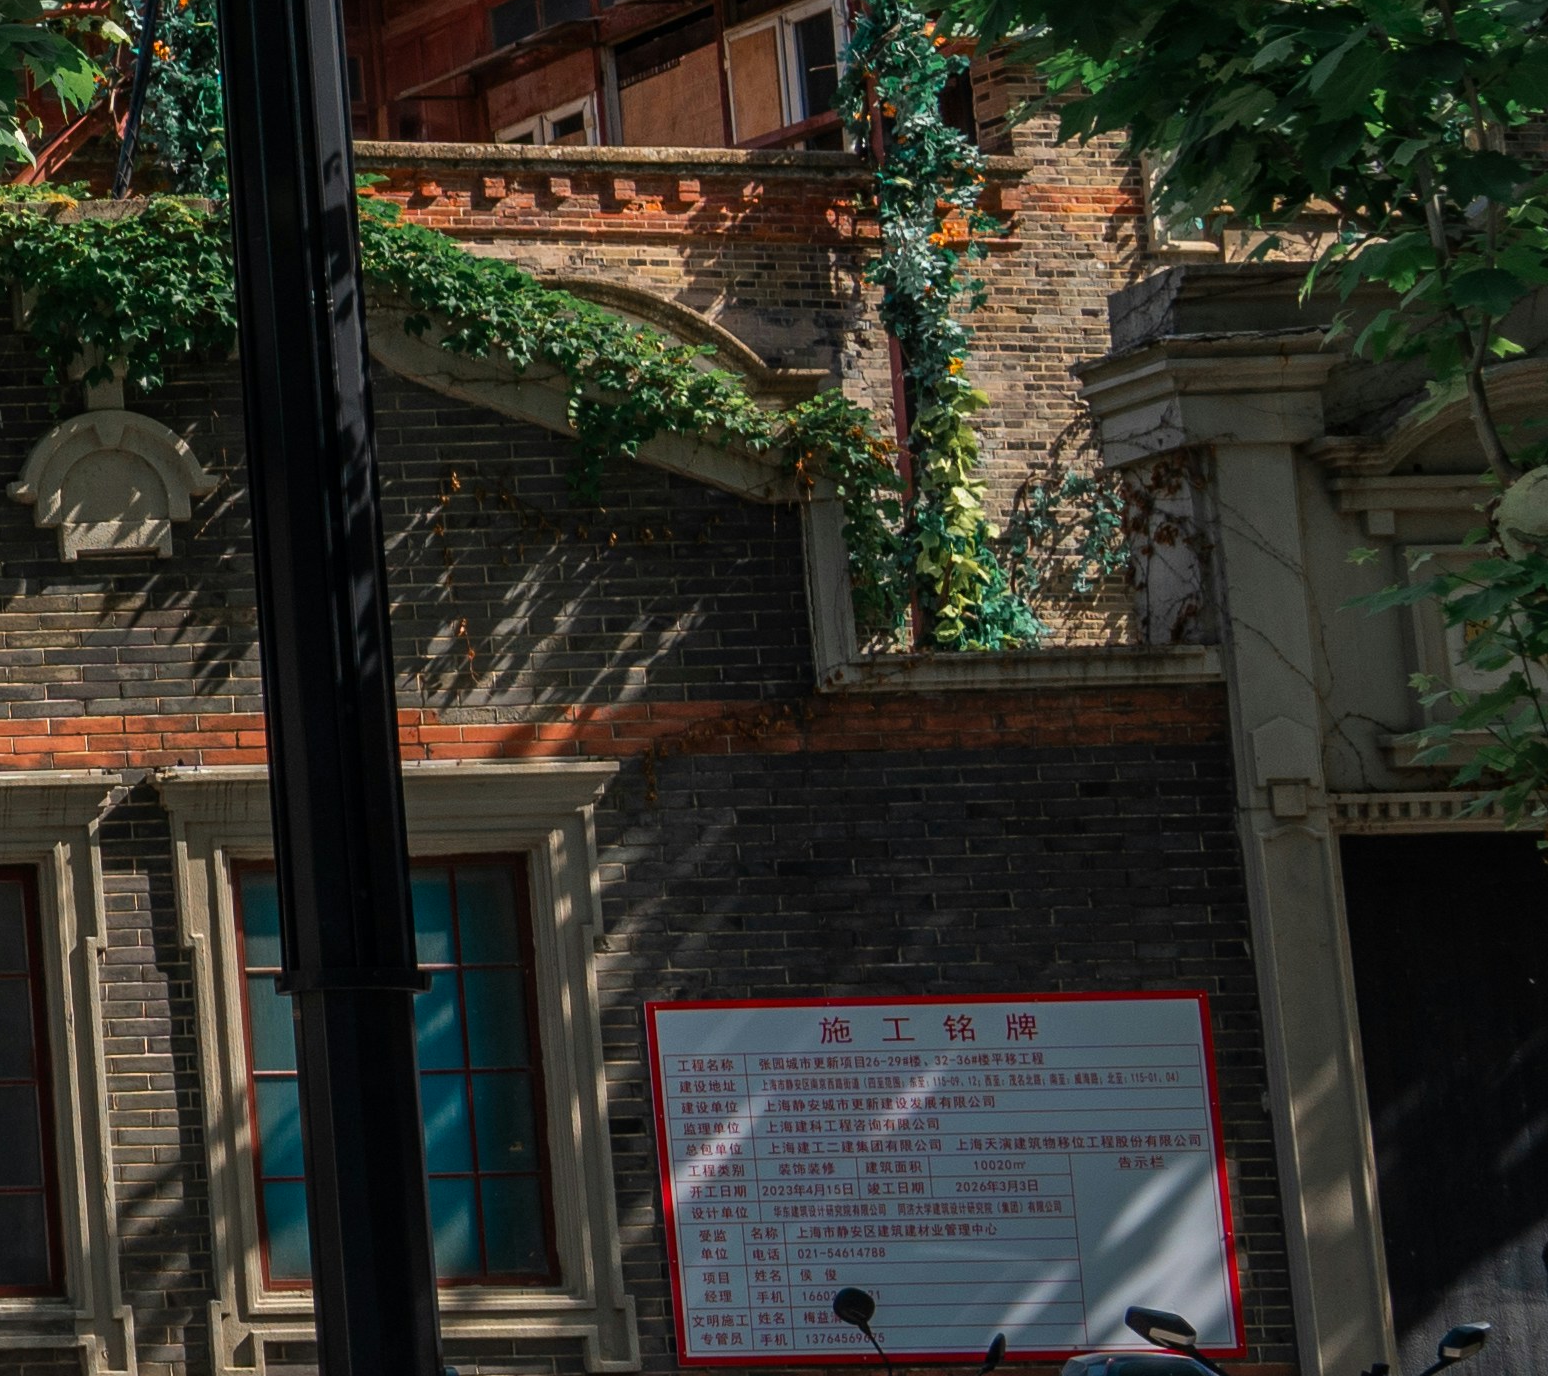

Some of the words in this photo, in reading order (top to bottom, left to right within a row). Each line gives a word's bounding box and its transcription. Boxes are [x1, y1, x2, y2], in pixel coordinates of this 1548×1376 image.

[819, 1013, 1038, 1044] 施工铭牌
[678, 1058, 735, 1072] 工程名称
[679, 1080, 736, 1093] 建设地址
[681, 1101, 738, 1114] 建设单位
[764, 1095, 996, 1113] 上海静安城市更新建设发展有限公司
[683, 1122, 740, 1135] 监理单位
[766, 1117, 940, 1133] 上海建科工程咨询有限公司
[685, 1143, 743, 1156] 总包单位
[768, 1138, 942, 1155] 上海建工二建集团有限公司
[1118, 1155, 1165, 1168] 告示栏
[688, 1164, 745, 1177] 工程类别
[779, 1162, 835, 1175] 装饰装修
[865, 1160, 923, 1174] 建筑面积
[690, 1185, 747, 1198] 开工日期
[762, 1182, 853, 1197] 2023年4月15日
[867, 1181, 924, 1195] 竣工日期
[956, 1179, 1039, 1193] 2026年3月3日
[691, 1206, 748, 1219] 设计单位
[699, 1229, 727, 1242] 受监
[751, 1227, 778, 1240] 名称
[798, 1223, 997, 1239] 上海市静安区建筑建材业管理中心
[701, 1248, 728, 1260] 单位
[752, 1248, 780, 1261] 电话
[797, 1247, 885, 1259] 021-54614788
[703, 1272, 729, 1284] 项目
[755, 1269, 781, 1282] 姓名
[704, 1290, 732, 1303] 经理
[757, 1291, 784, 1303] 手机
[693, 1314, 749, 1328] 文明施工
[758, 1312, 785, 1324] 姓名
[701, 1332, 743, 1345] 专管员
[761, 1333, 787, 1346] 手机
